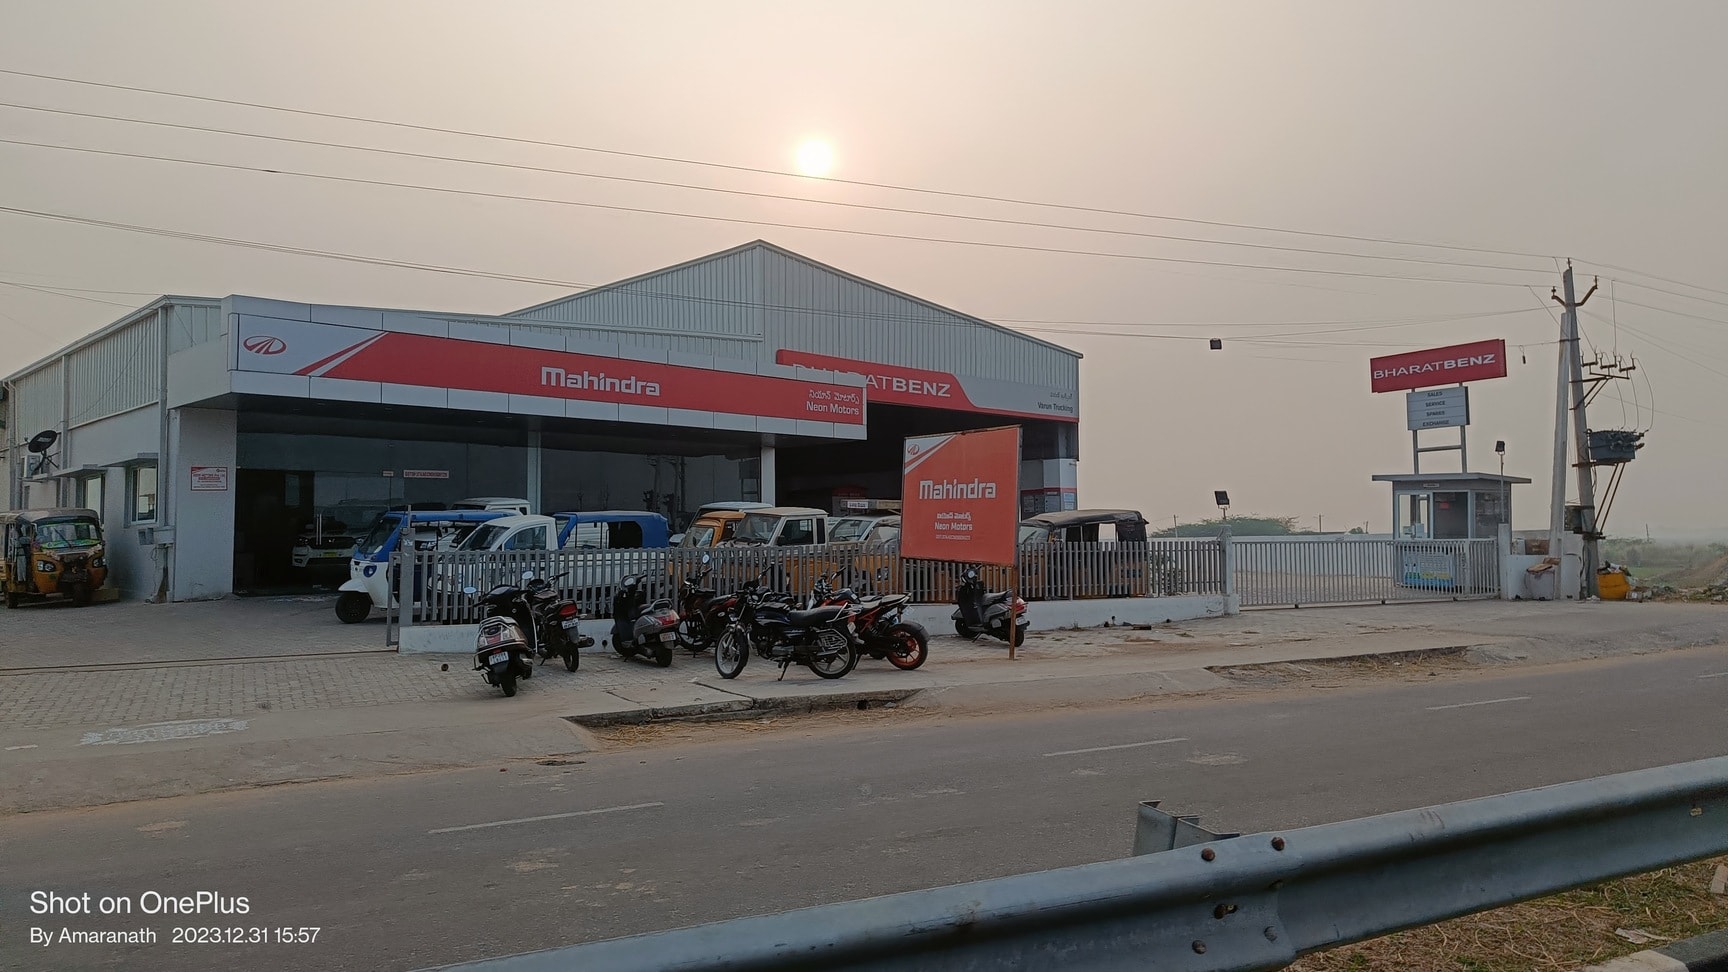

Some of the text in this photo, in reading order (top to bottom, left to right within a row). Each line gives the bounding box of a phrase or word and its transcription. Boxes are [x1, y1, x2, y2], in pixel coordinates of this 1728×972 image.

[1374, 354, 1496, 379] BHARATBENZ
[541, 366, 660, 396] Mahindra
[806, 401, 860, 415] Neon Motors
[919, 478, 996, 499] Mahindra
[935, 521, 972, 531] Neon Motors
